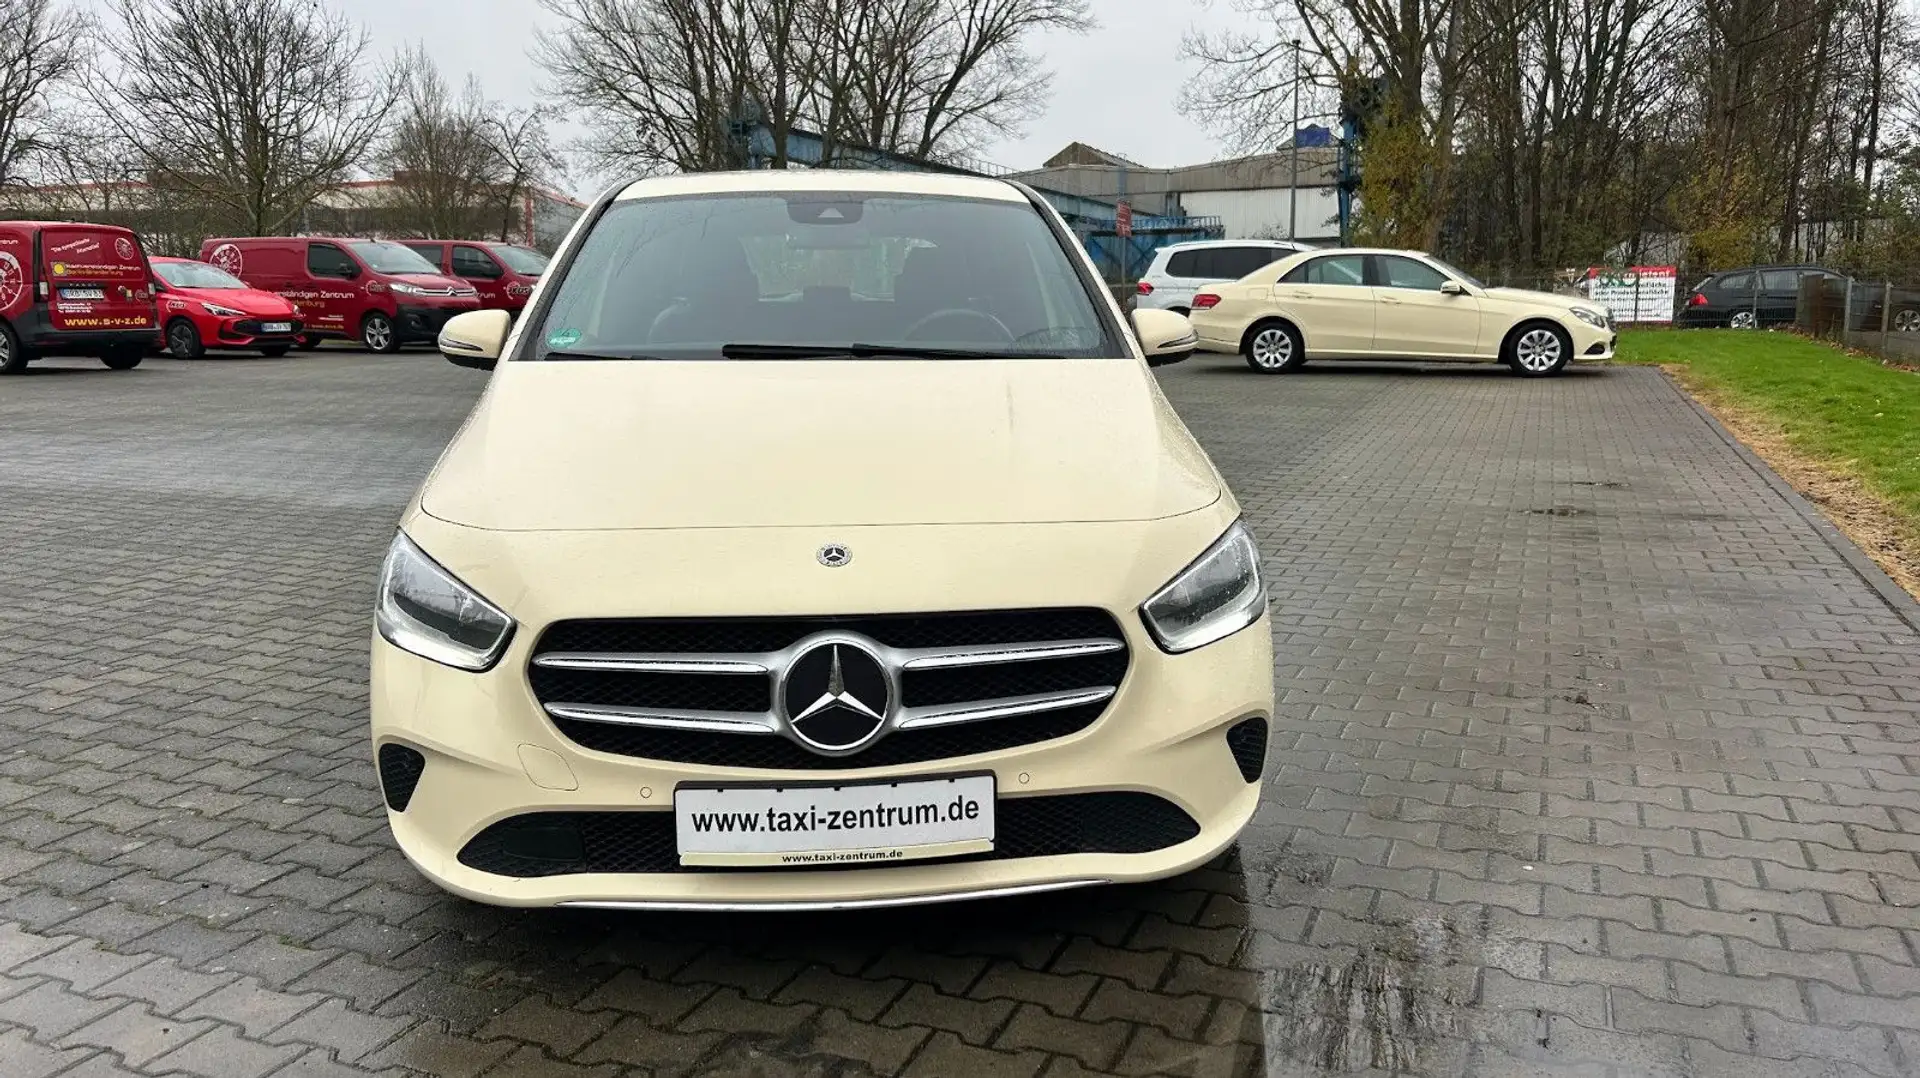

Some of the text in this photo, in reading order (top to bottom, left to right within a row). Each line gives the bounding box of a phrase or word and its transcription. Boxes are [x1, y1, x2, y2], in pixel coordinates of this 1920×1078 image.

[320, 290, 355, 299] Zentrum
[63, 315, 147, 326] www.s-v-z.de
[691, 795, 980, 833] www.taxi-zentrum.de
[782, 850, 903, 863] www.taxi-zentrum.de
